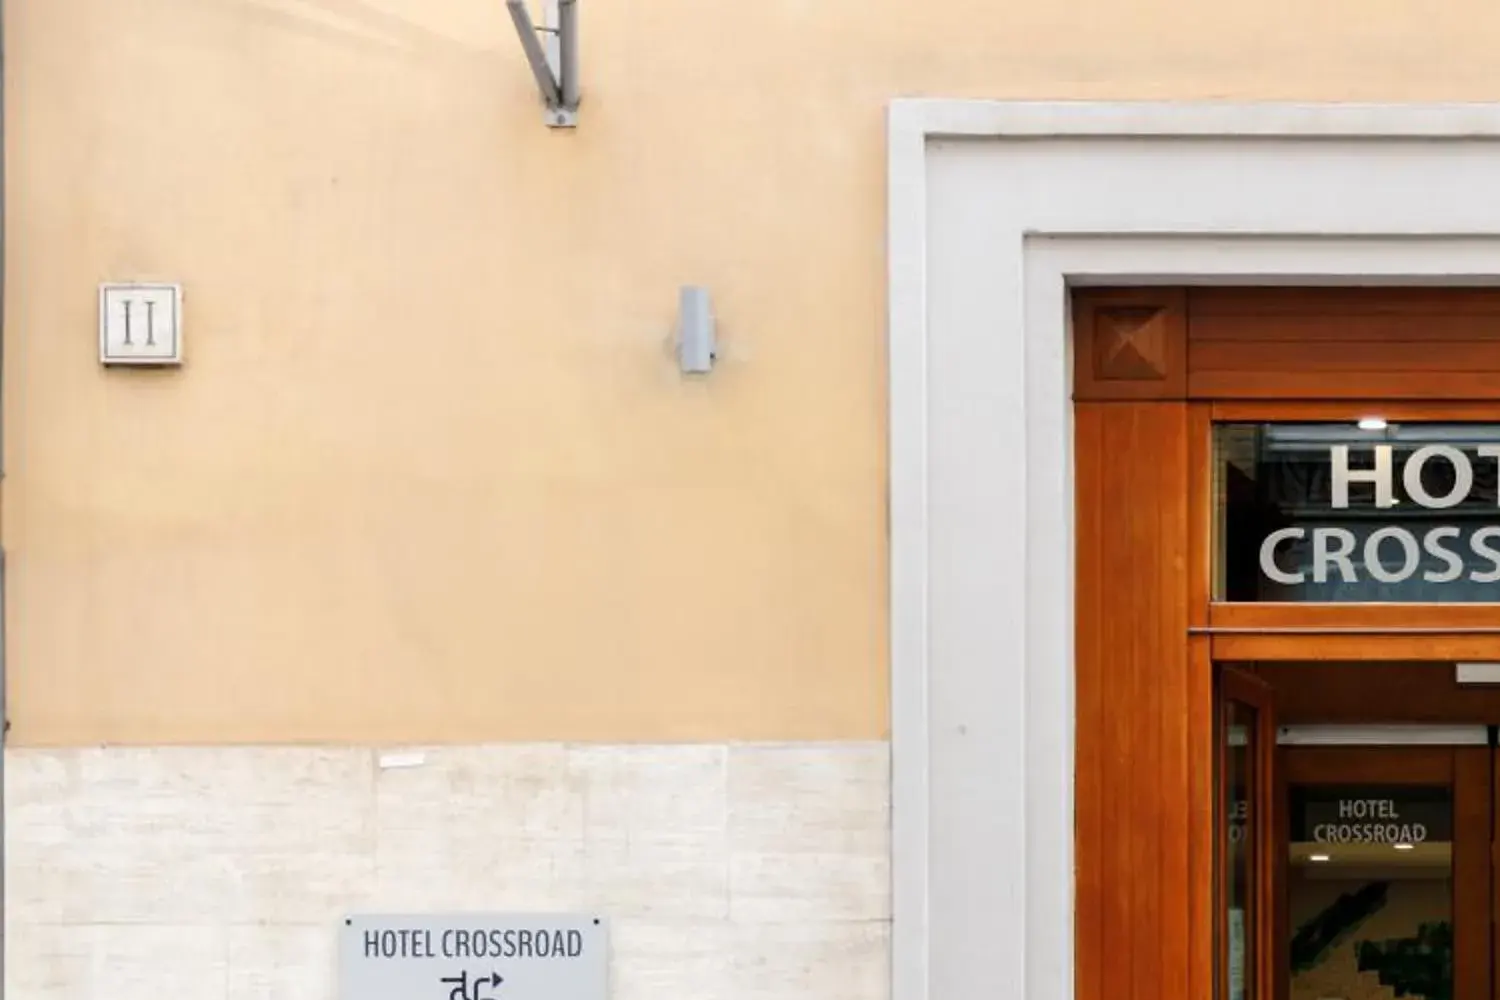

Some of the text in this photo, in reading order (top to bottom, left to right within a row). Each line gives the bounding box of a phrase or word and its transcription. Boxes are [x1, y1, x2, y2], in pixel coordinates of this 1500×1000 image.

[1339, 799, 1399, 819] HOTEL
[1313, 823, 1428, 844] CROSSROAD
[364, 928, 583, 959] HOTEL CROSSROAD
